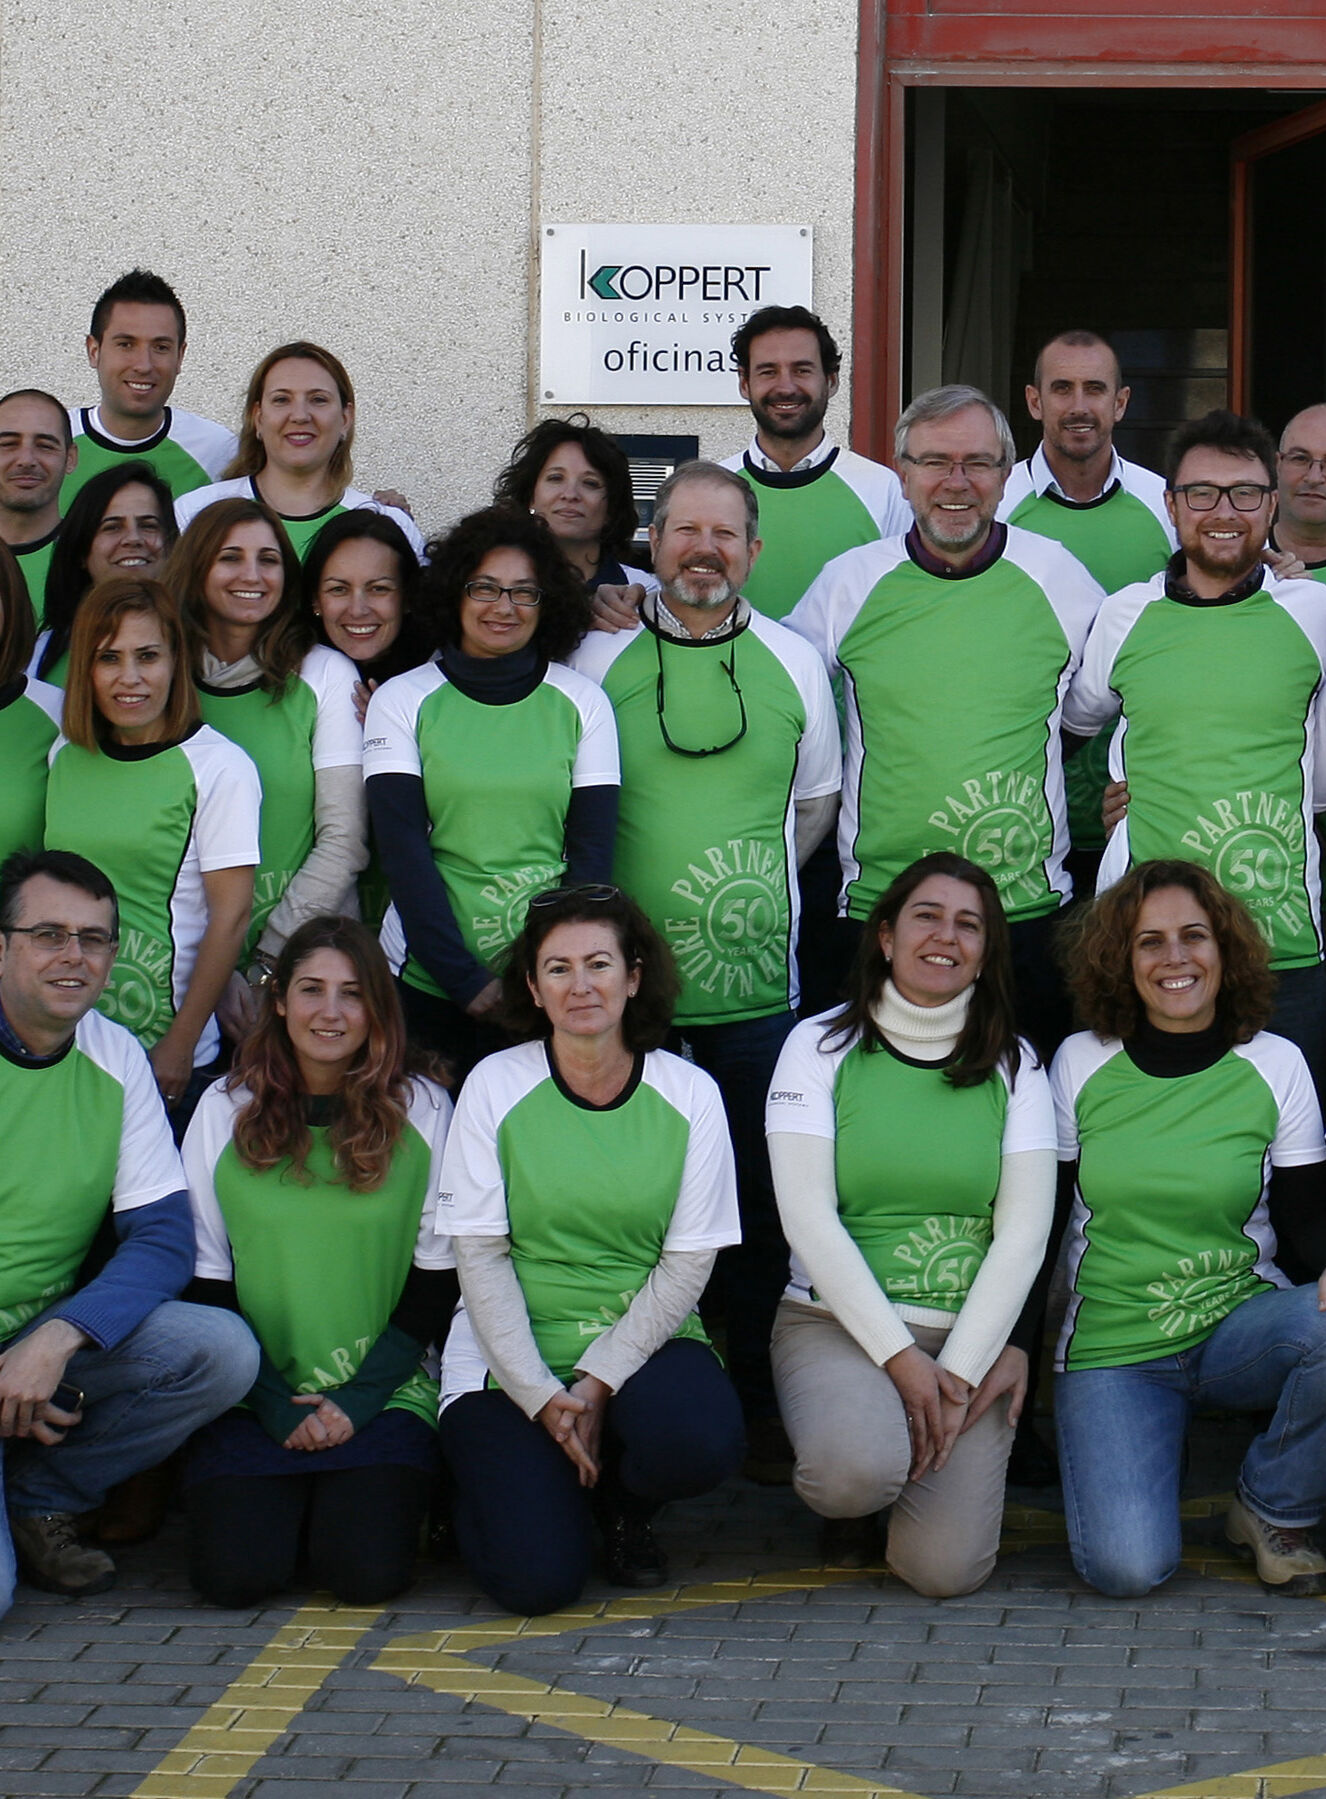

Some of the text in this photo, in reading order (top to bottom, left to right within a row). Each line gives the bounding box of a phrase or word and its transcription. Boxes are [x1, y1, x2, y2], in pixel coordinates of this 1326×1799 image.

[580, 249, 771, 301] KOPPERT
[564, 312, 748, 323] BIOLOGICAL SYST
[1229, 848, 1283, 892] 50
[718, 896, 772, 941] 50
